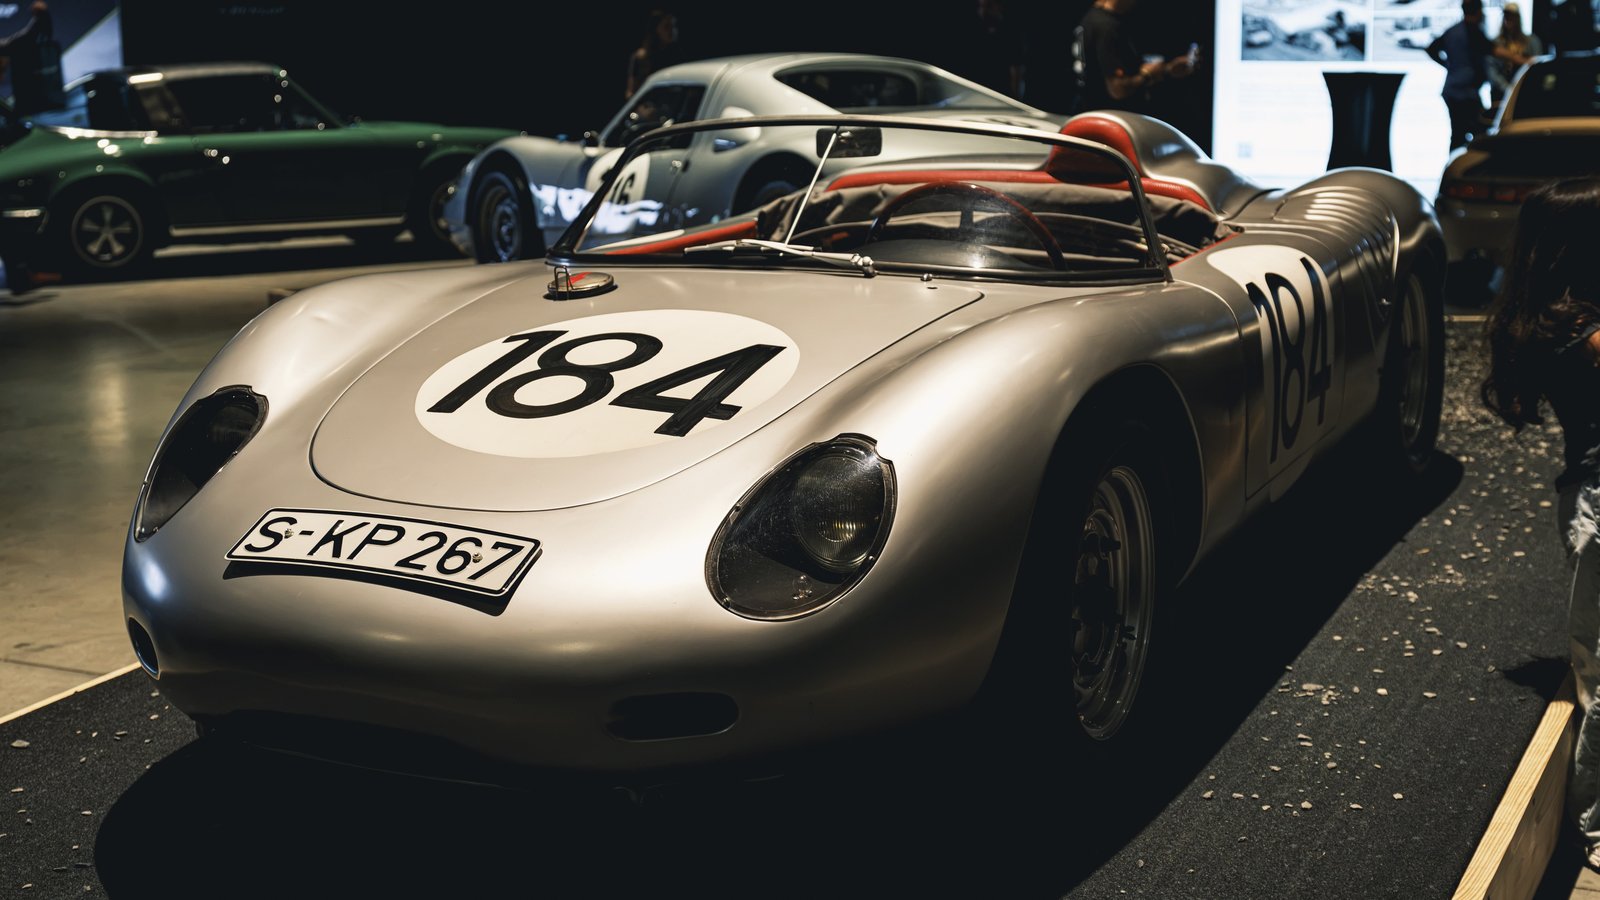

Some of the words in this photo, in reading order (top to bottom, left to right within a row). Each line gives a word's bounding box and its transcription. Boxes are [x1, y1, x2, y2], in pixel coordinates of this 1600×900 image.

[426, 330, 787, 437] 184
[1246, 257, 1332, 464] 184
[244, 516, 406, 560] S-KP
[395, 531, 525, 581] 267
